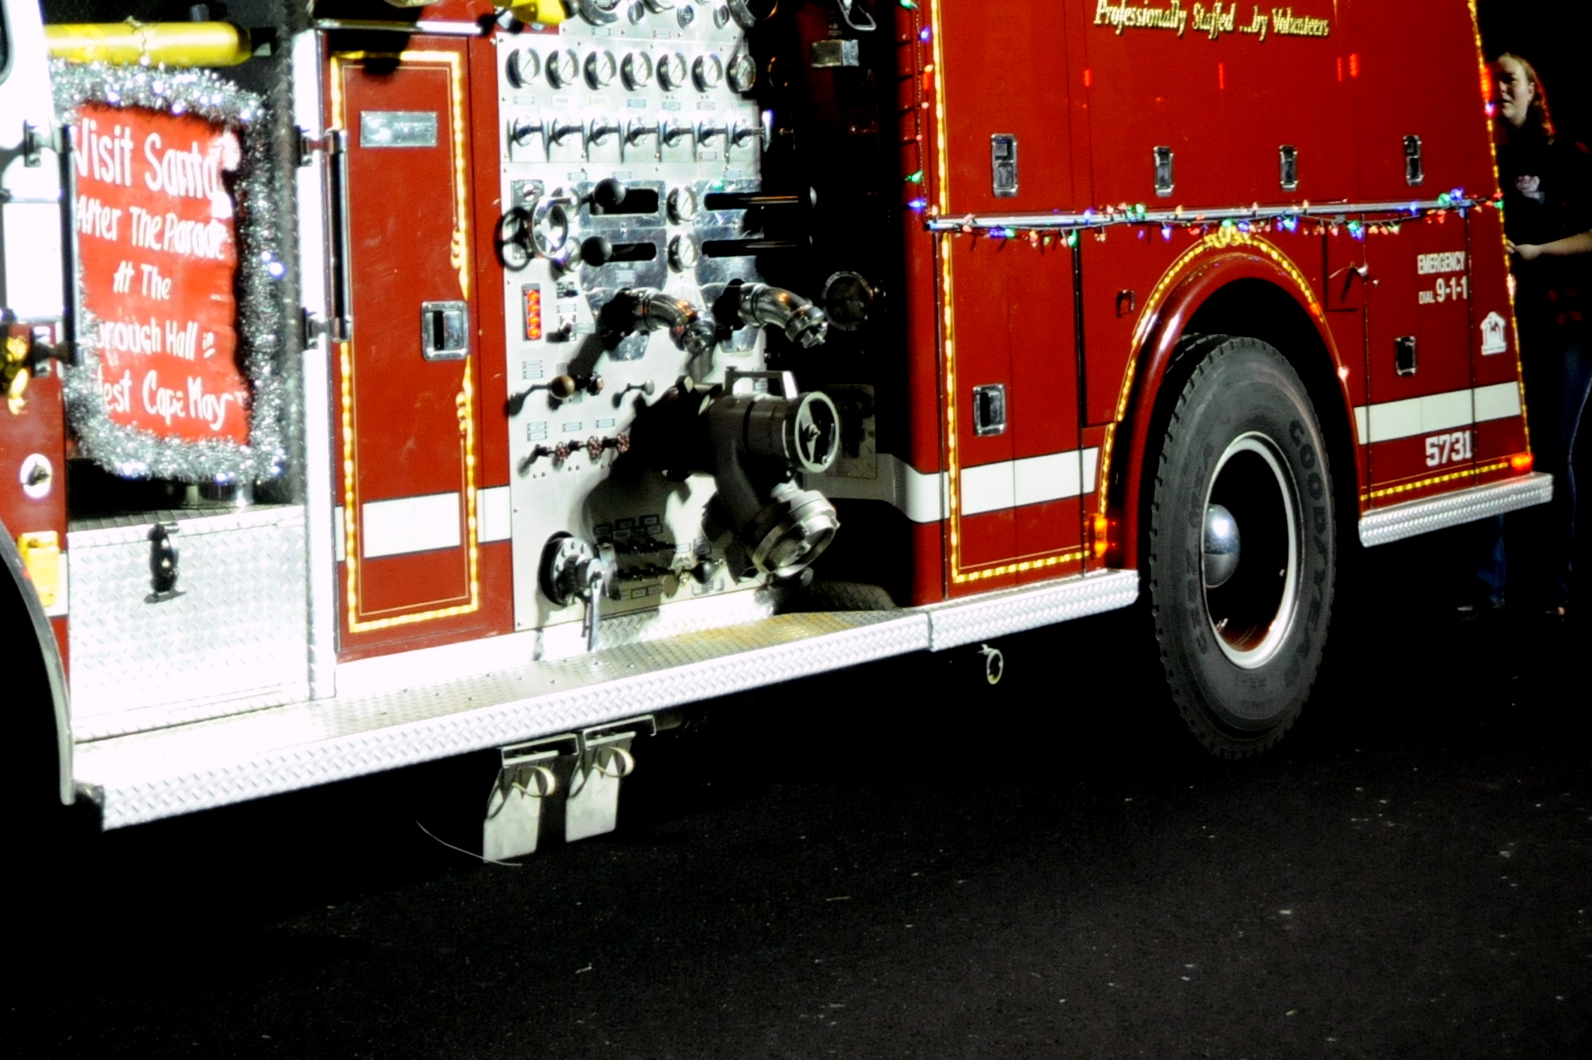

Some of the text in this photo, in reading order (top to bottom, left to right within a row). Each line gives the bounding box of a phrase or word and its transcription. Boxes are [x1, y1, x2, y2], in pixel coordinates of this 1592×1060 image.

[1192, 1, 1236, 39] Staffed
[1272, 7, 1329, 36] Volunteers
[73, 117, 134, 187] Visit
[77, 195, 228, 260] After The Parade
[113, 260, 172, 301] At The
[1417, 251, 1466, 275] EMERGENCY
[1419, 276, 1468, 304] DIAL 9-1-1
[94, 317, 161, 355] rough
[165, 320, 198, 361] Hall
[142, 369, 185, 426] Cape
[1425, 430, 1472, 467] 5731
